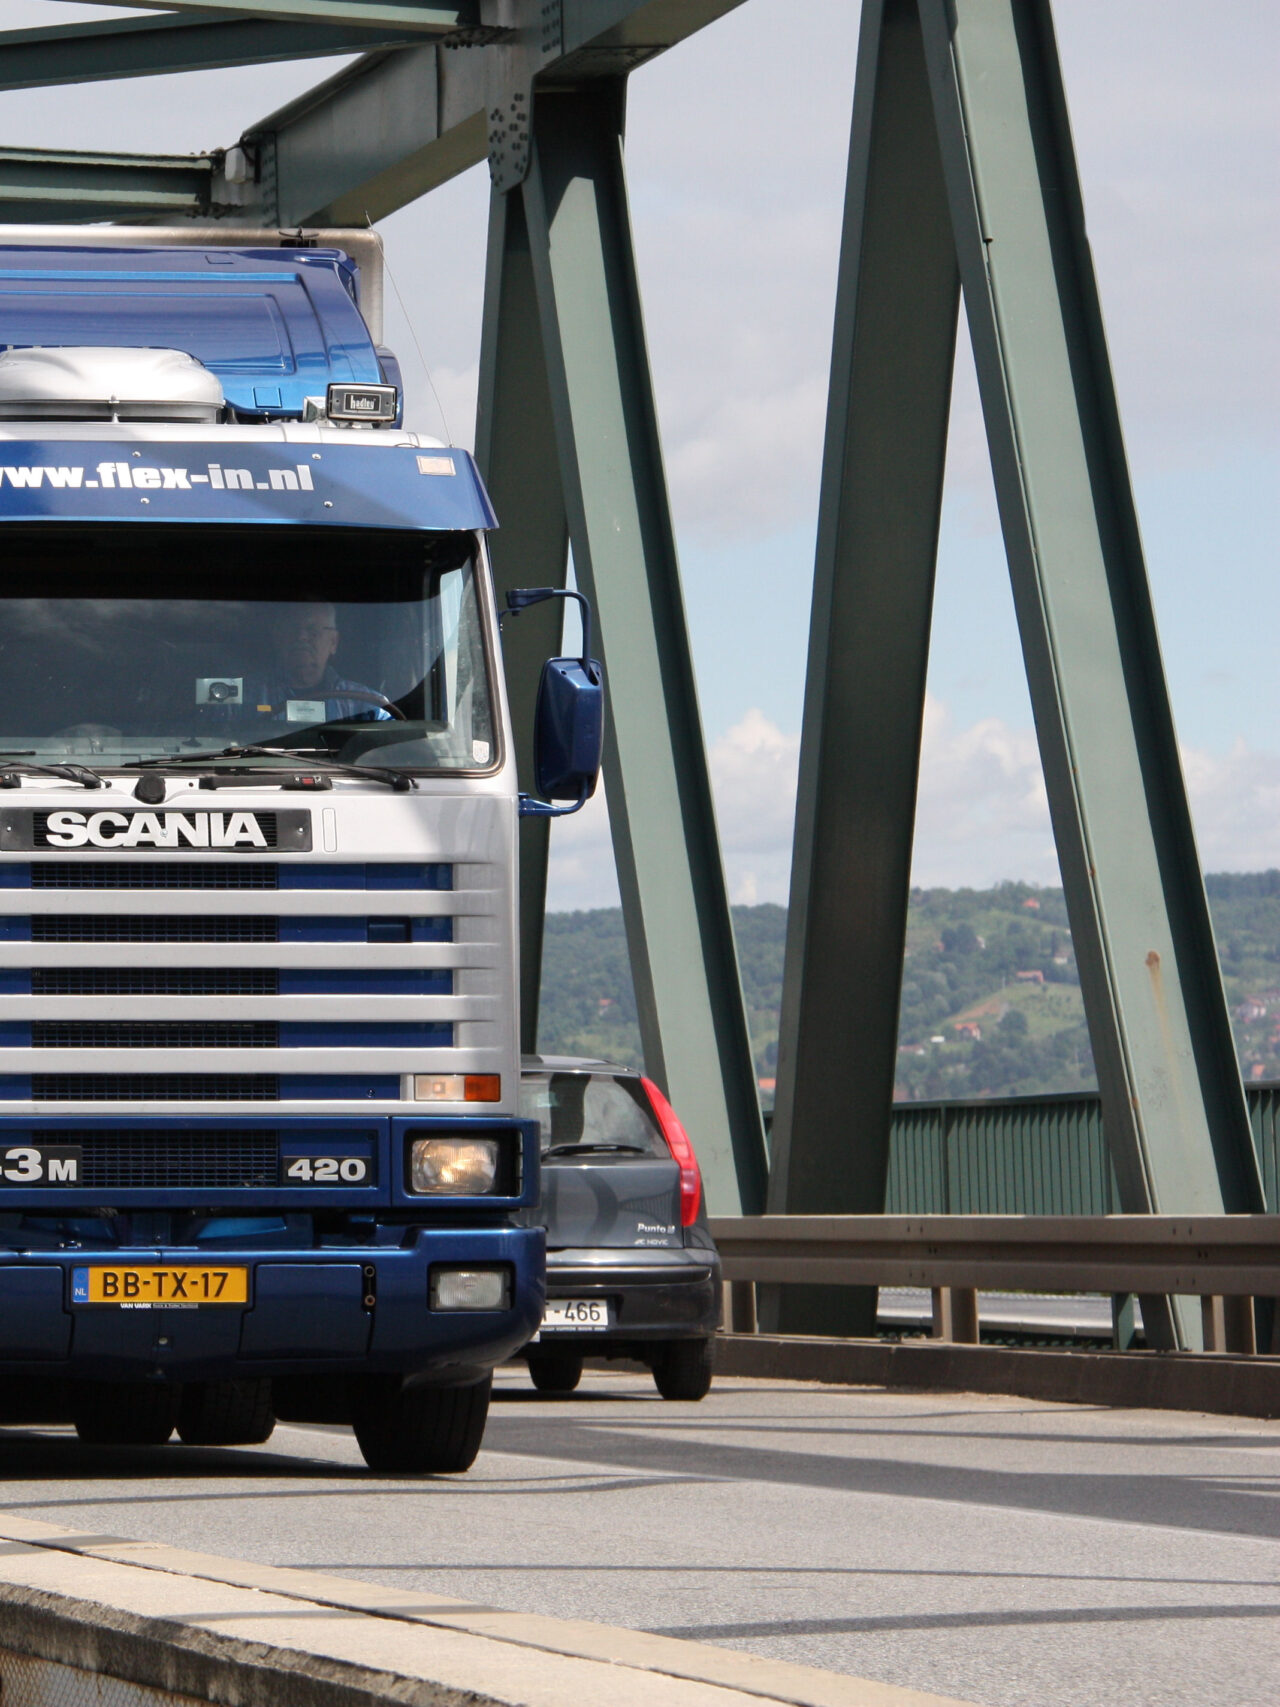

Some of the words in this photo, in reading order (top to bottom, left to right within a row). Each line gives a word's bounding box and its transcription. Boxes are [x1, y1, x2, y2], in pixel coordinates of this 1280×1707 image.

[350, 394, 376, 410] hadley
[45, 811, 268, 848] SCANIA
[286, 1158, 367, 1183] 420
[637, 1223, 666, 1234] Punto
[74, 1287, 87, 1296] NL
[102, 1272, 229, 1298] BB-TX-17
